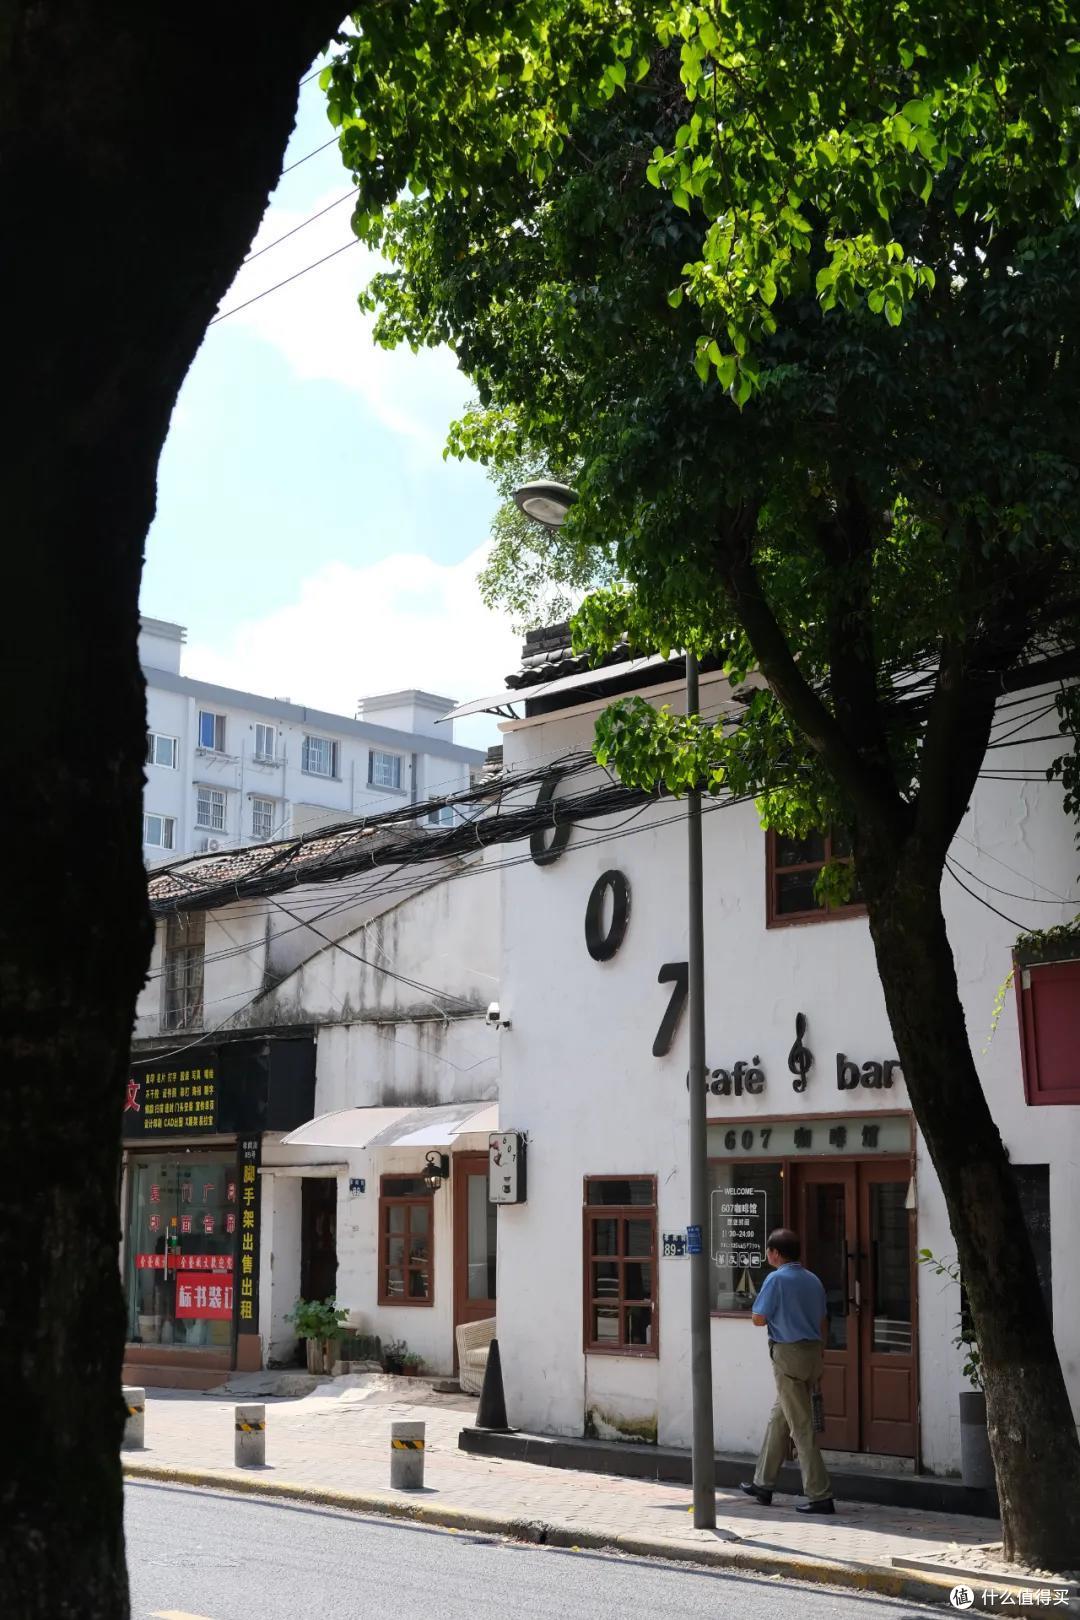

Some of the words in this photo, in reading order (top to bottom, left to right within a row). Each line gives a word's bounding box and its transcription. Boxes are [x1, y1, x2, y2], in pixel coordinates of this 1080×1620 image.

[836, 1052, 905, 1091] bar
[724, 1129, 772, 1150] 607
[793, 1124, 880, 1149] 咖啡馆
[724, 1187, 755, 1196] WELCOME
[721, 1202, 758, 1215] 607咖啡馆
[241, 1165, 257, 1320] 脚手架出售出租
